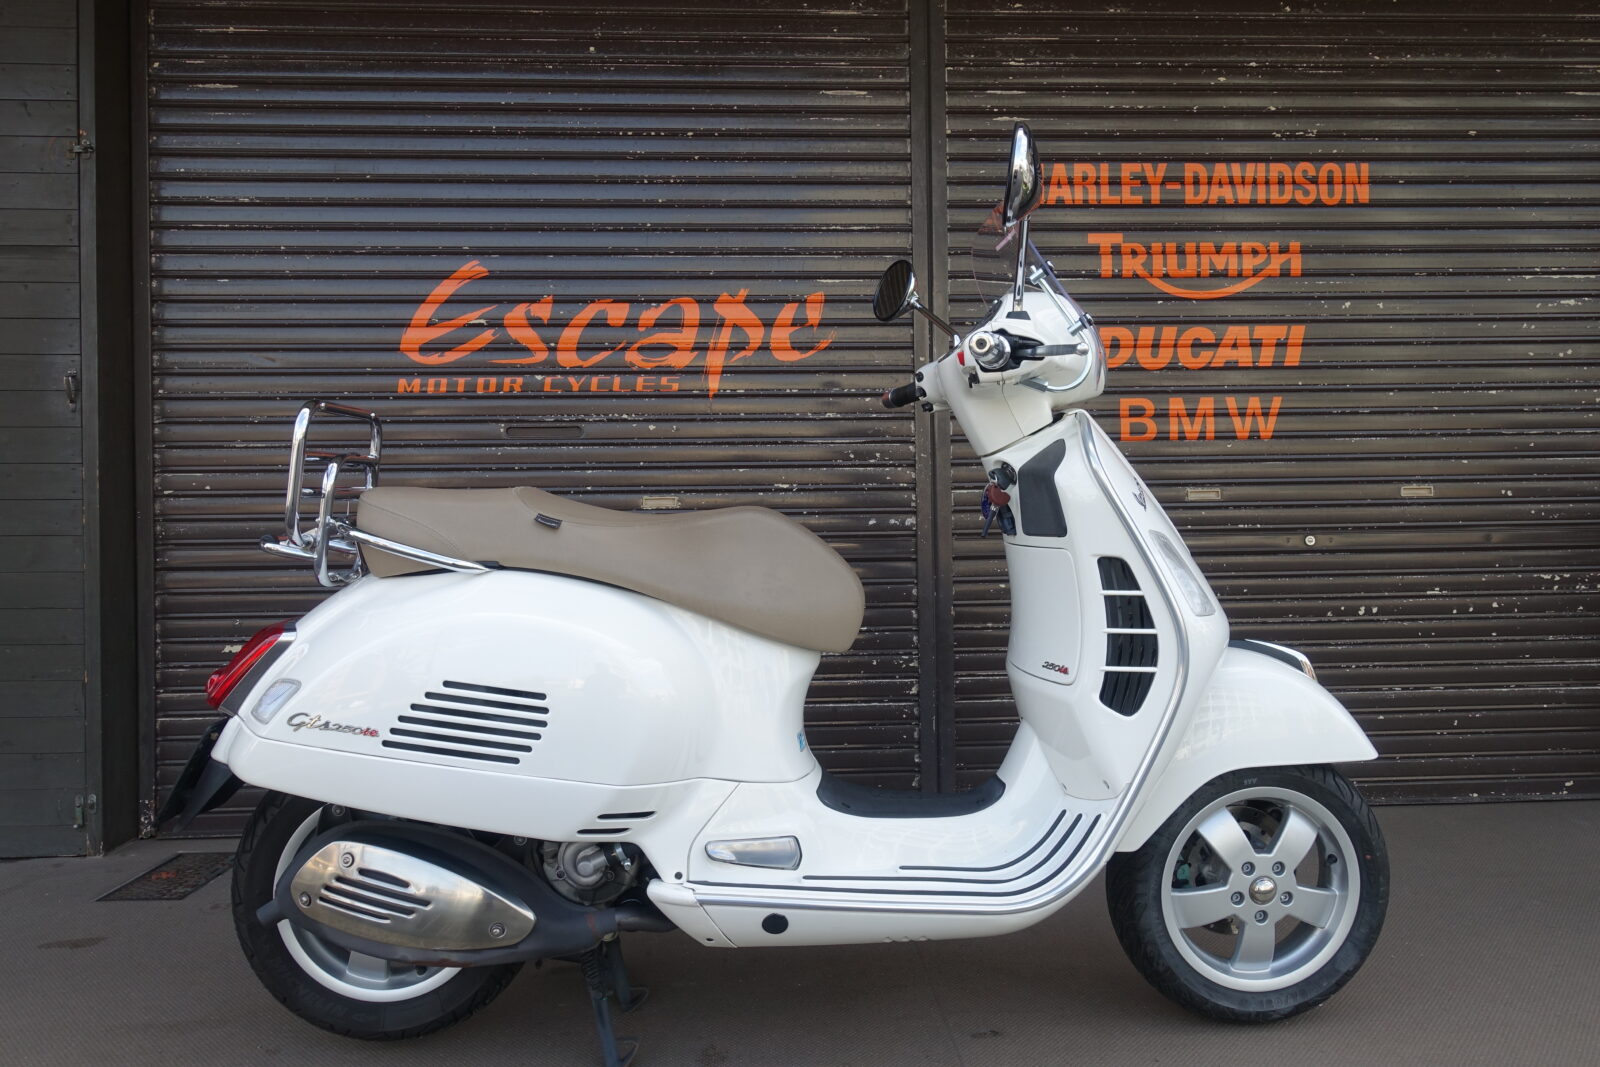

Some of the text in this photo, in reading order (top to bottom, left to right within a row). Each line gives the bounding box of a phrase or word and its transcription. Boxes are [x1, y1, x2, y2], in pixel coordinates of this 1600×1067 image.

[1040, 162, 1370, 205] ARLEY-DAVIDSON
[1087, 233, 1302, 299] TRIUMPH
[400, 260, 832, 400] Escape
[1099, 325, 1306, 370] DUCATI
[397, 376, 680, 393] MOTOR CYCLES
[1119, 396, 1283, 442] BMW
